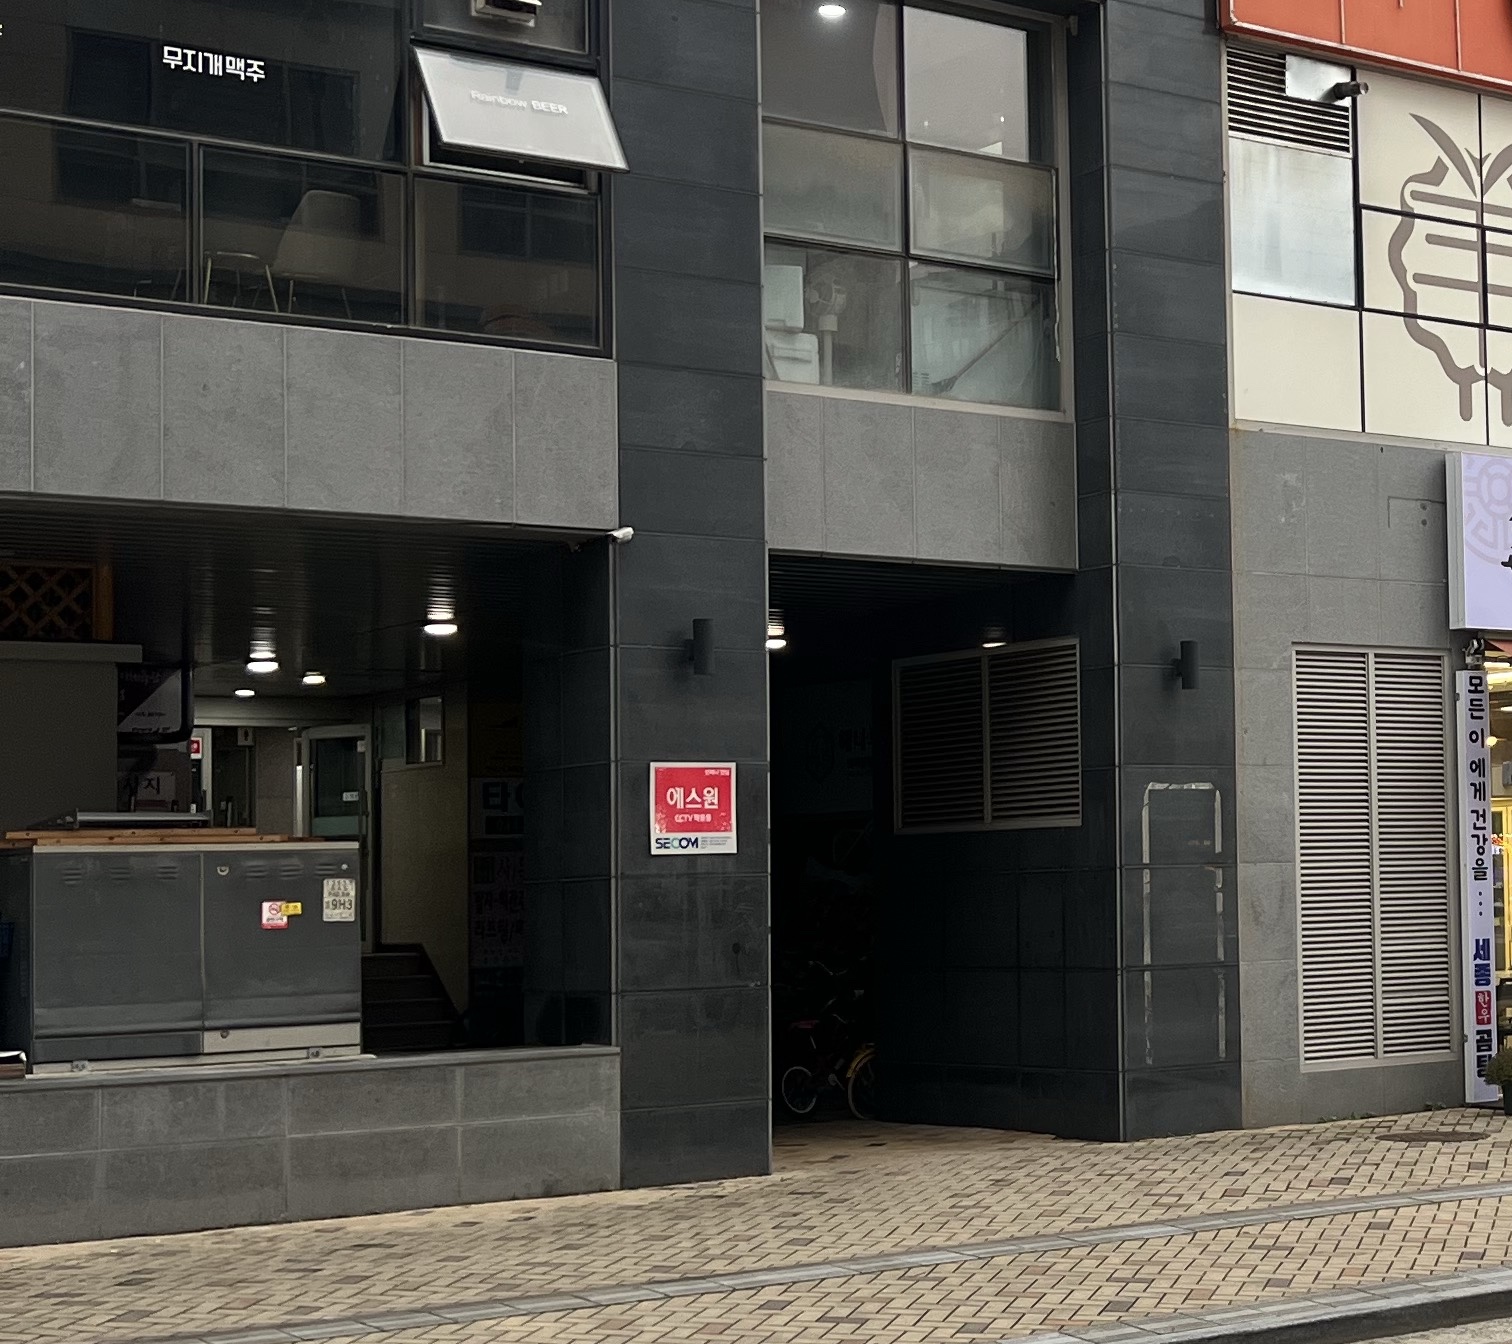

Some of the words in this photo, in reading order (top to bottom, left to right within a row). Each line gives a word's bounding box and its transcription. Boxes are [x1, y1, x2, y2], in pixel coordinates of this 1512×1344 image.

[470, 89, 527, 109] Rainbow
[531, 100, 569, 115] BEER
[1468, 676, 1484, 720] 모든
[666, 787, 719, 809] 에스원
[655, 837, 699, 849] SECOM
[1474, 938, 1491, 986] 세종
[1477, 992, 1490, 1023] 한우
